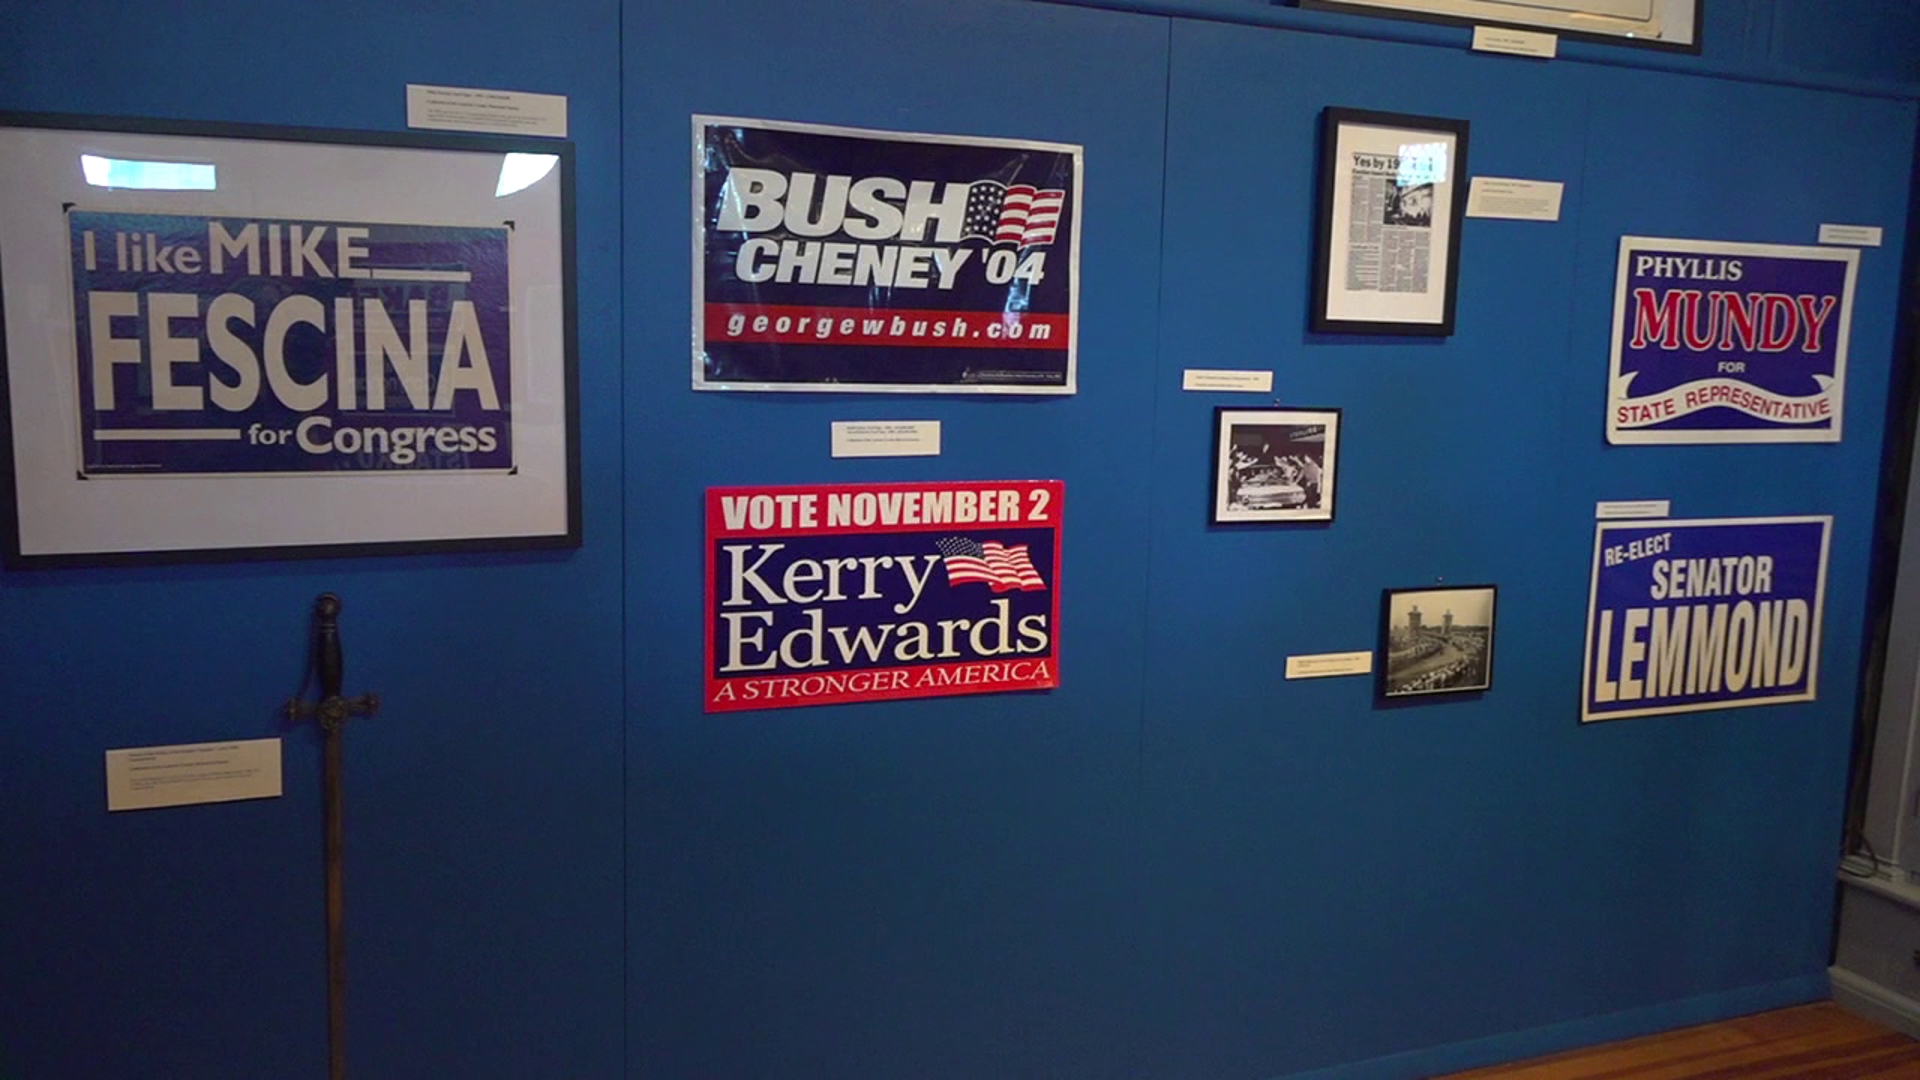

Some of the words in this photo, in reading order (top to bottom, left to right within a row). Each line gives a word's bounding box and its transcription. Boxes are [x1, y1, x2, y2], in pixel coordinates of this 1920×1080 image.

[1353, 155, 1371, 167] Yes
[1373, 157, 1384, 169] by
[717, 166, 970, 242] BUSH
[84, 230, 96, 271] I
[116, 231, 202, 274] like
[209, 221, 371, 279] MIKE
[735, 238, 973, 290] CHENEY
[981, 248, 1045, 286] '04
[1636, 255, 1743, 282] PHYLLIS
[727, 313, 1051, 340] georgewbush.com
[1629, 287, 1837, 353] MUNDY
[88, 292, 501, 412] FESCINA
[1717, 361, 1746, 373] FOR
[1617, 398, 1676, 424] STATE
[1685, 385, 1831, 420] REPRESENTATIVE
[249, 422, 292, 445] for
[296, 416, 497, 464] Congress
[720, 494, 818, 530] VOTE
[827, 490, 1020, 527] NOVEMBER
[1028, 489, 1049, 521] 2
[1604, 532, 1672, 568] RE-ELECT
[720, 543, 941, 614] Kerry
[1650, 555, 1774, 601] SENATOR
[719, 598, 1049, 673] Edwards
[1595, 597, 1810, 703] LEMMOND
[713, 680, 737, 703] A
[742, 669, 910, 700] STRONGER
[913, 661, 1050, 689] AMERICA
